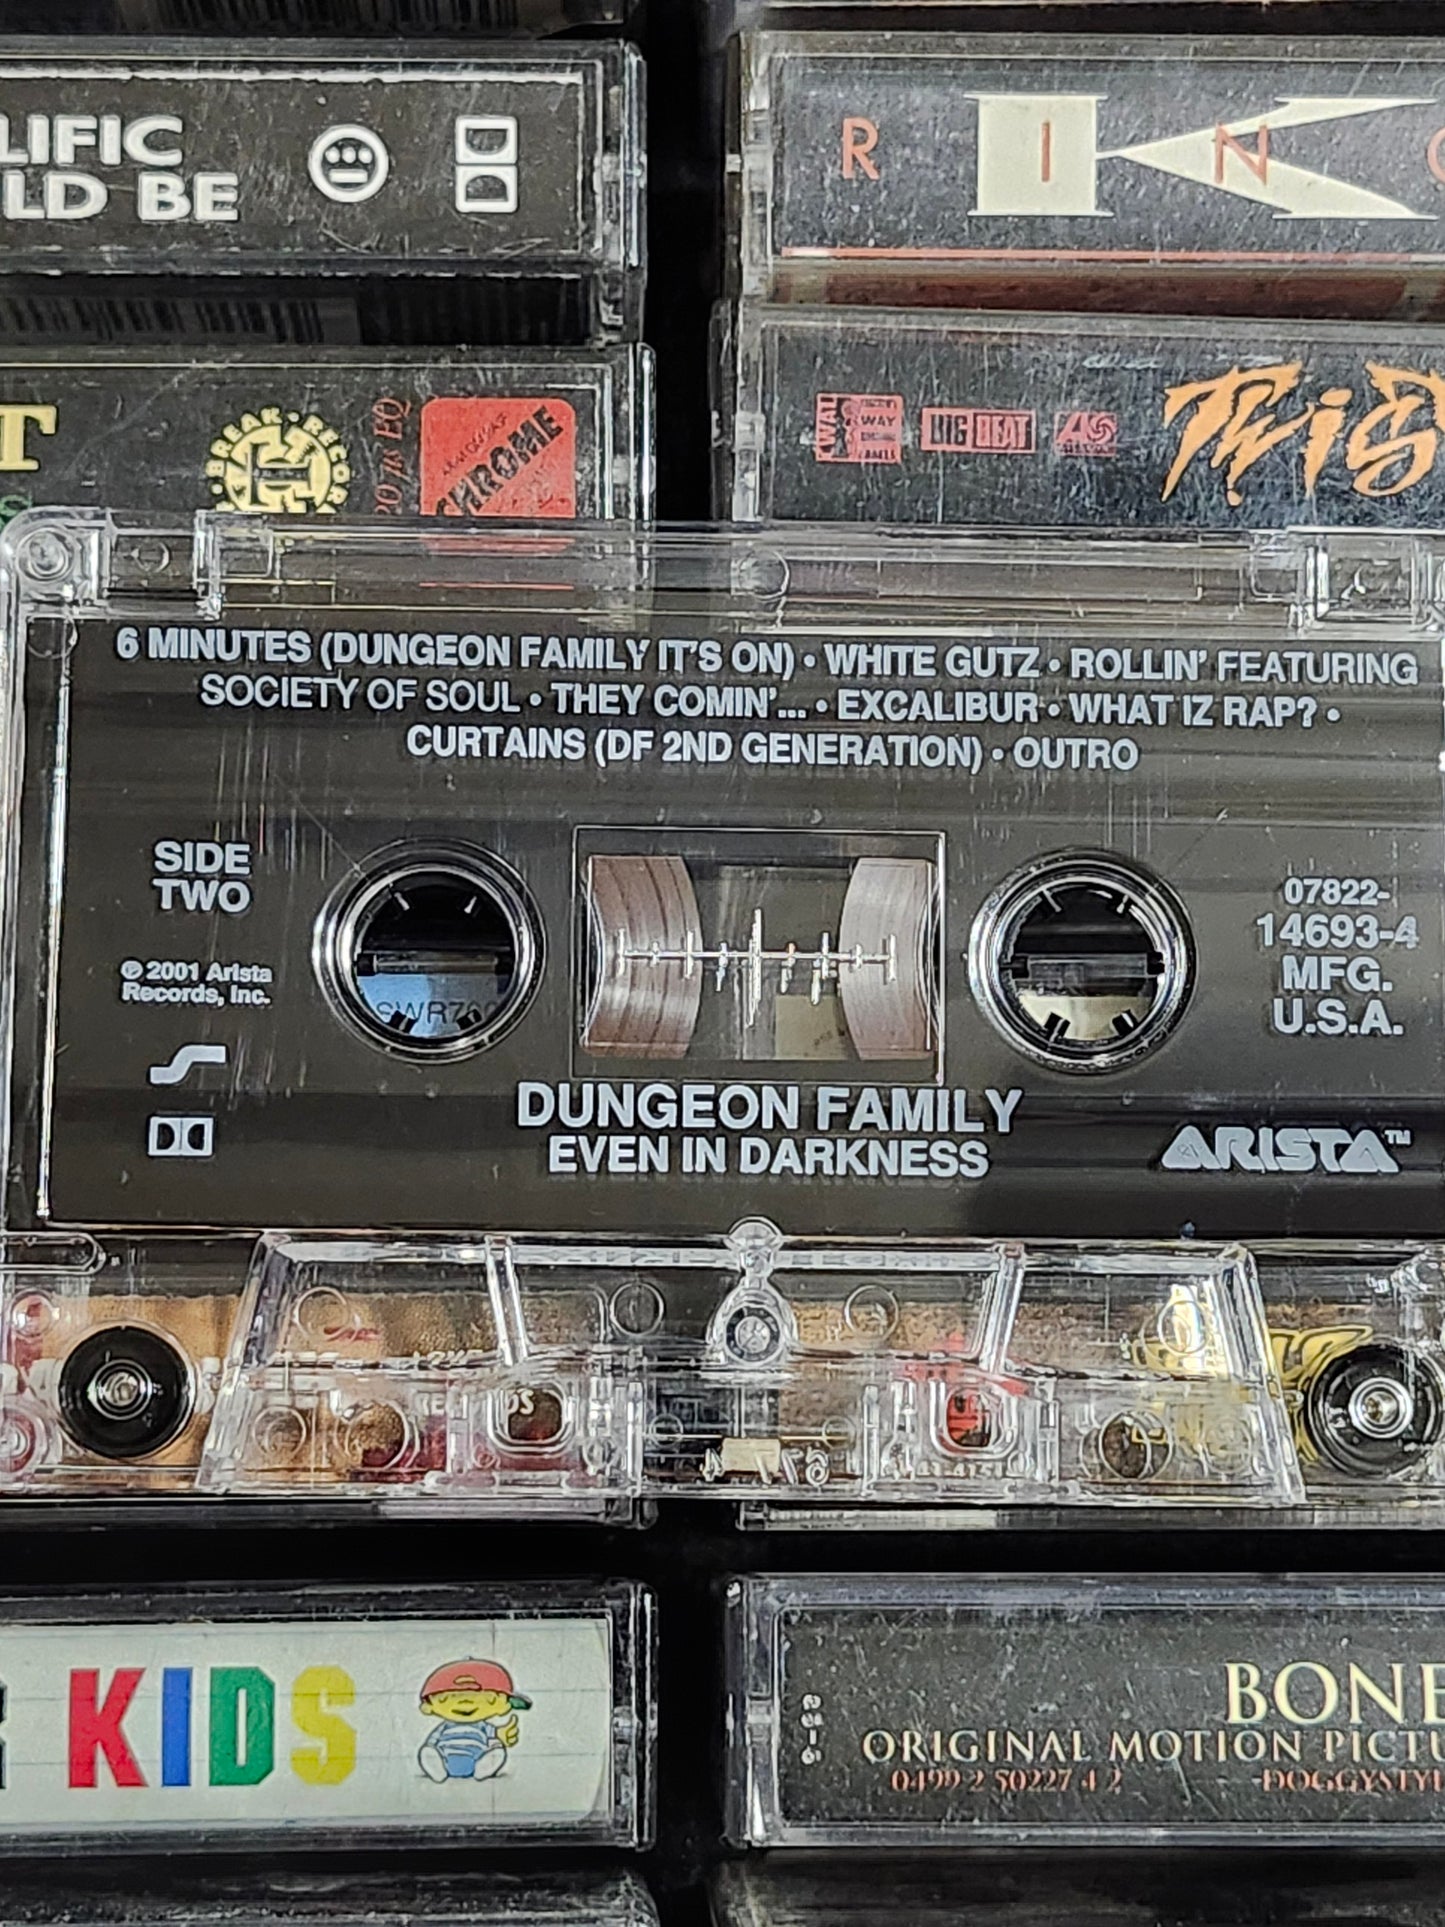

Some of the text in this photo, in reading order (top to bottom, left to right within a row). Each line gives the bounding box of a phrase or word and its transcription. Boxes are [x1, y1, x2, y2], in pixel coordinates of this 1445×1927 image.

[4, 170, 239, 221] LD BE
[931, 413, 1031, 448] BIG BEAT
[116, 627, 1419, 686] 6 MINUTES (DUNGEON FAMILY IT'S ON) WHITE GUTZ ROLLIN' FEATURING
[200, 673, 359, 710] SOCIETY
[366, 677, 417, 711] OF
[425, 679, 520, 713] SOUL
[550, 683, 645, 716] THEY
[837, 689, 1039, 722] EXCALIBUR
[1068, 692, 1174, 726] WHAT
[1182, 694, 1214, 727] IZ
[1223, 695, 1318, 729] RAP?
[407, 724, 1139, 774] CURTAINS (DF 2ND GENERATION) OUTRO
[154, 841, 251, 875] SIDE
[152, 878, 251, 914] TWO
[1284, 876, 1391, 906] 07822-
[1257, 912, 1420, 949] 14693-4
[146, 961, 199, 981] 2001
[206, 962, 273, 983] Arista
[1282, 954, 1394, 991] MFG.
[122, 982, 271, 1006] Records, Inc.
[1272, 997, 1404, 1035] U.S.A.
[516, 1082, 1024, 1133] DUNGEON FAMILY
[548, 1134, 990, 1178] EVEN IN DARKNESS
[1161, 1125, 1400, 1173] ARISTA
[1224, 1660, 1445, 1725] BONE
[67, 1665, 358, 1789] KIDS
[863, 1729, 1092, 1764] ORIGINAL
[1108, 1730, 1302, 1763] MOTION
